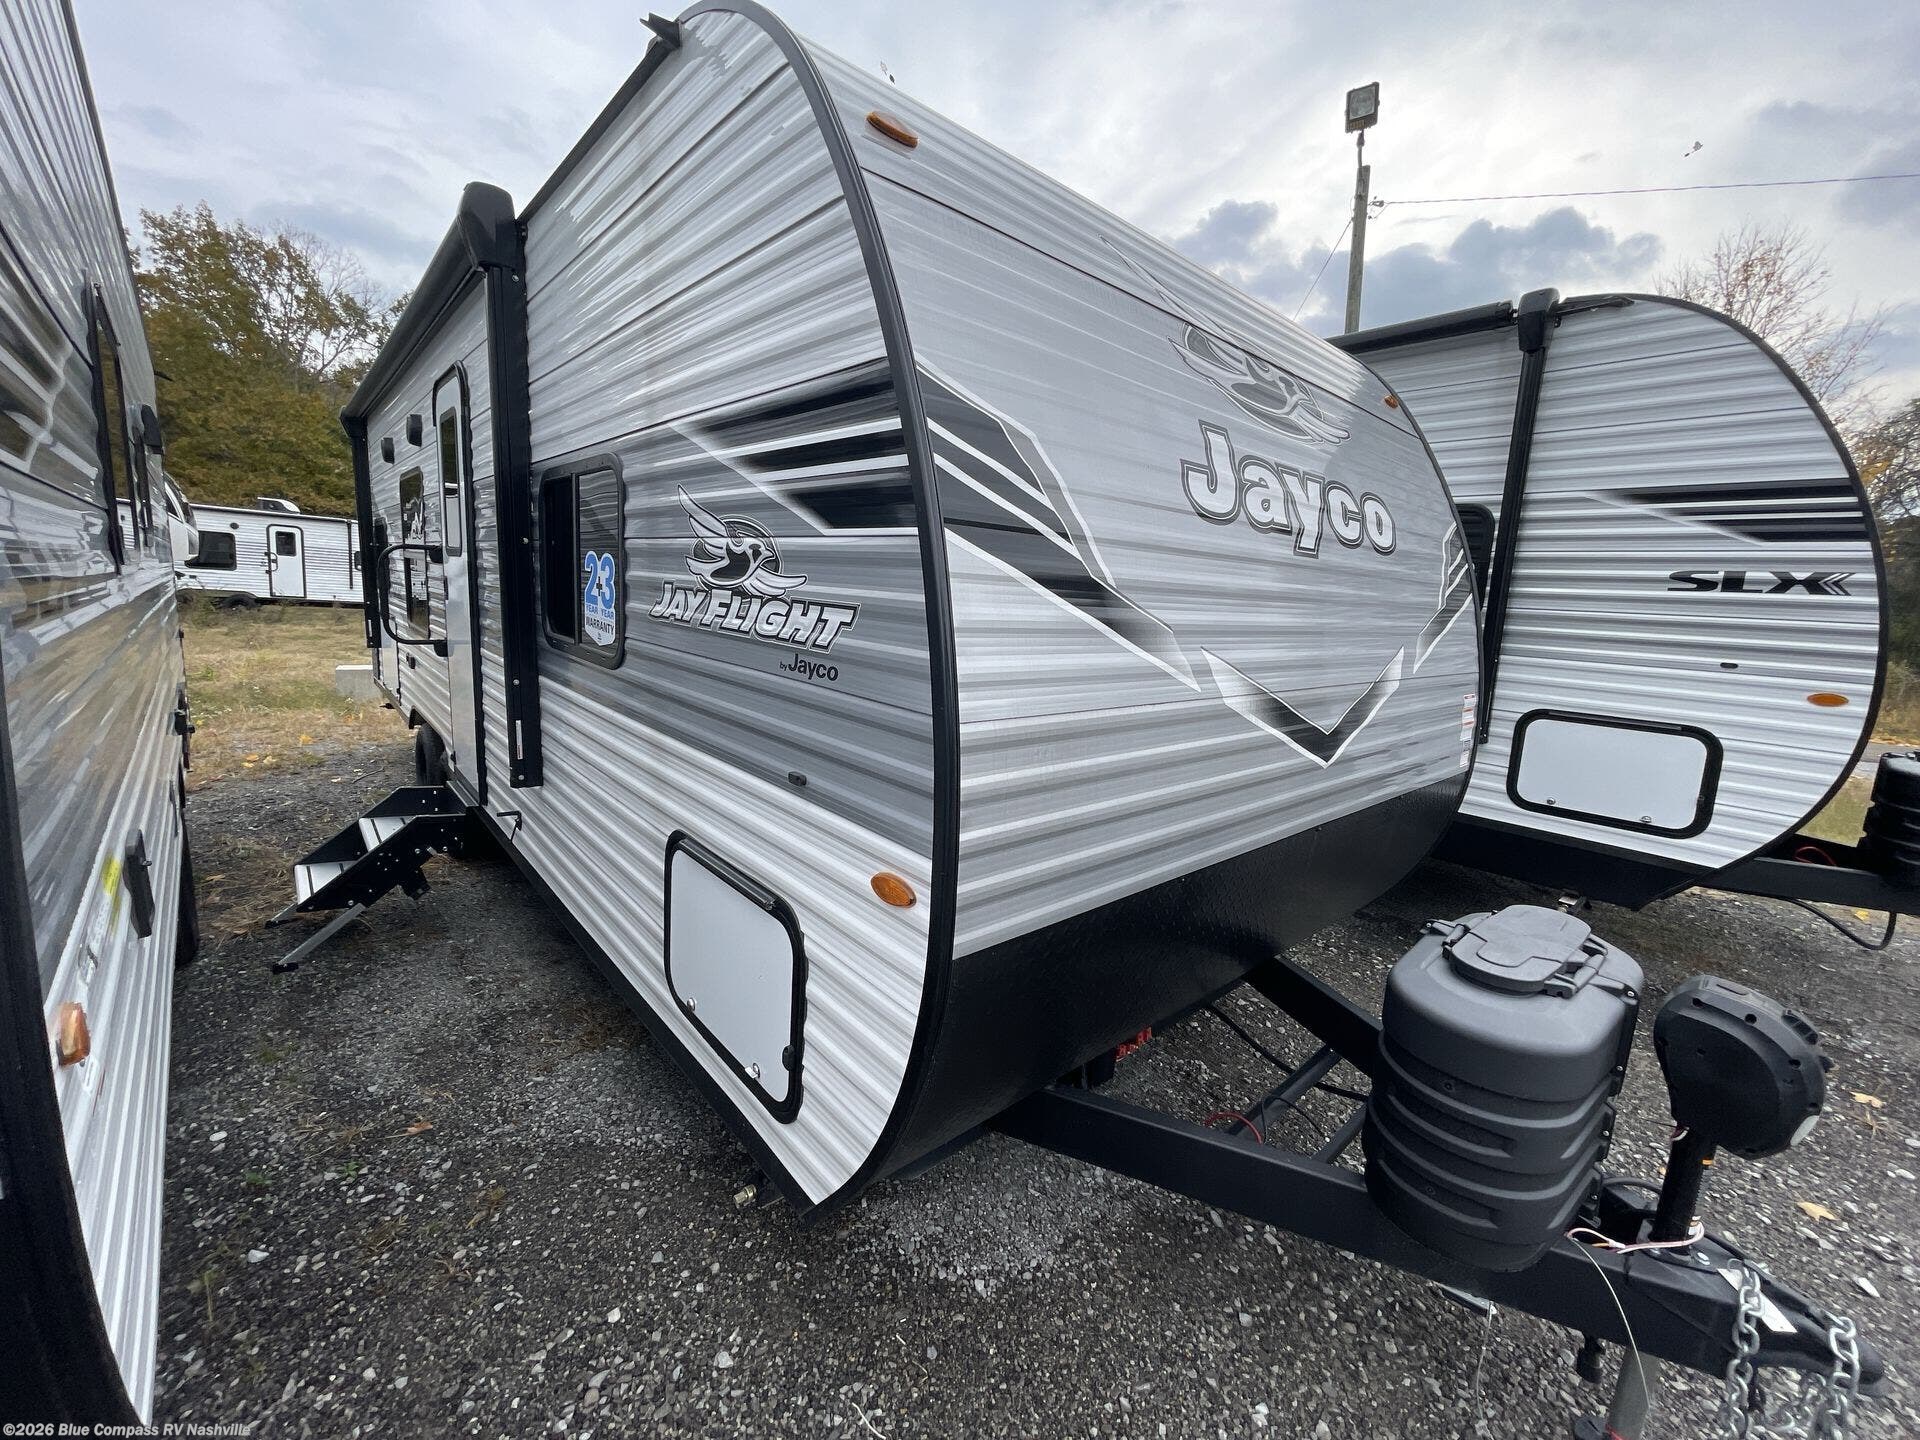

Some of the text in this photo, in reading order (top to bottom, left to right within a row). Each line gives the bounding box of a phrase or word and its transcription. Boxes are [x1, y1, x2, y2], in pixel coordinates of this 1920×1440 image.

[1180, 419, 1397, 558] Jayco
[1667, 570, 1855, 596] SLX
[586, 616, 614, 635] WARRANTY
[601, 608, 614, 620] YEAR
[649, 580, 860, 652] JAY FLIGHT
[779, 653, 839, 681] by Jayco
